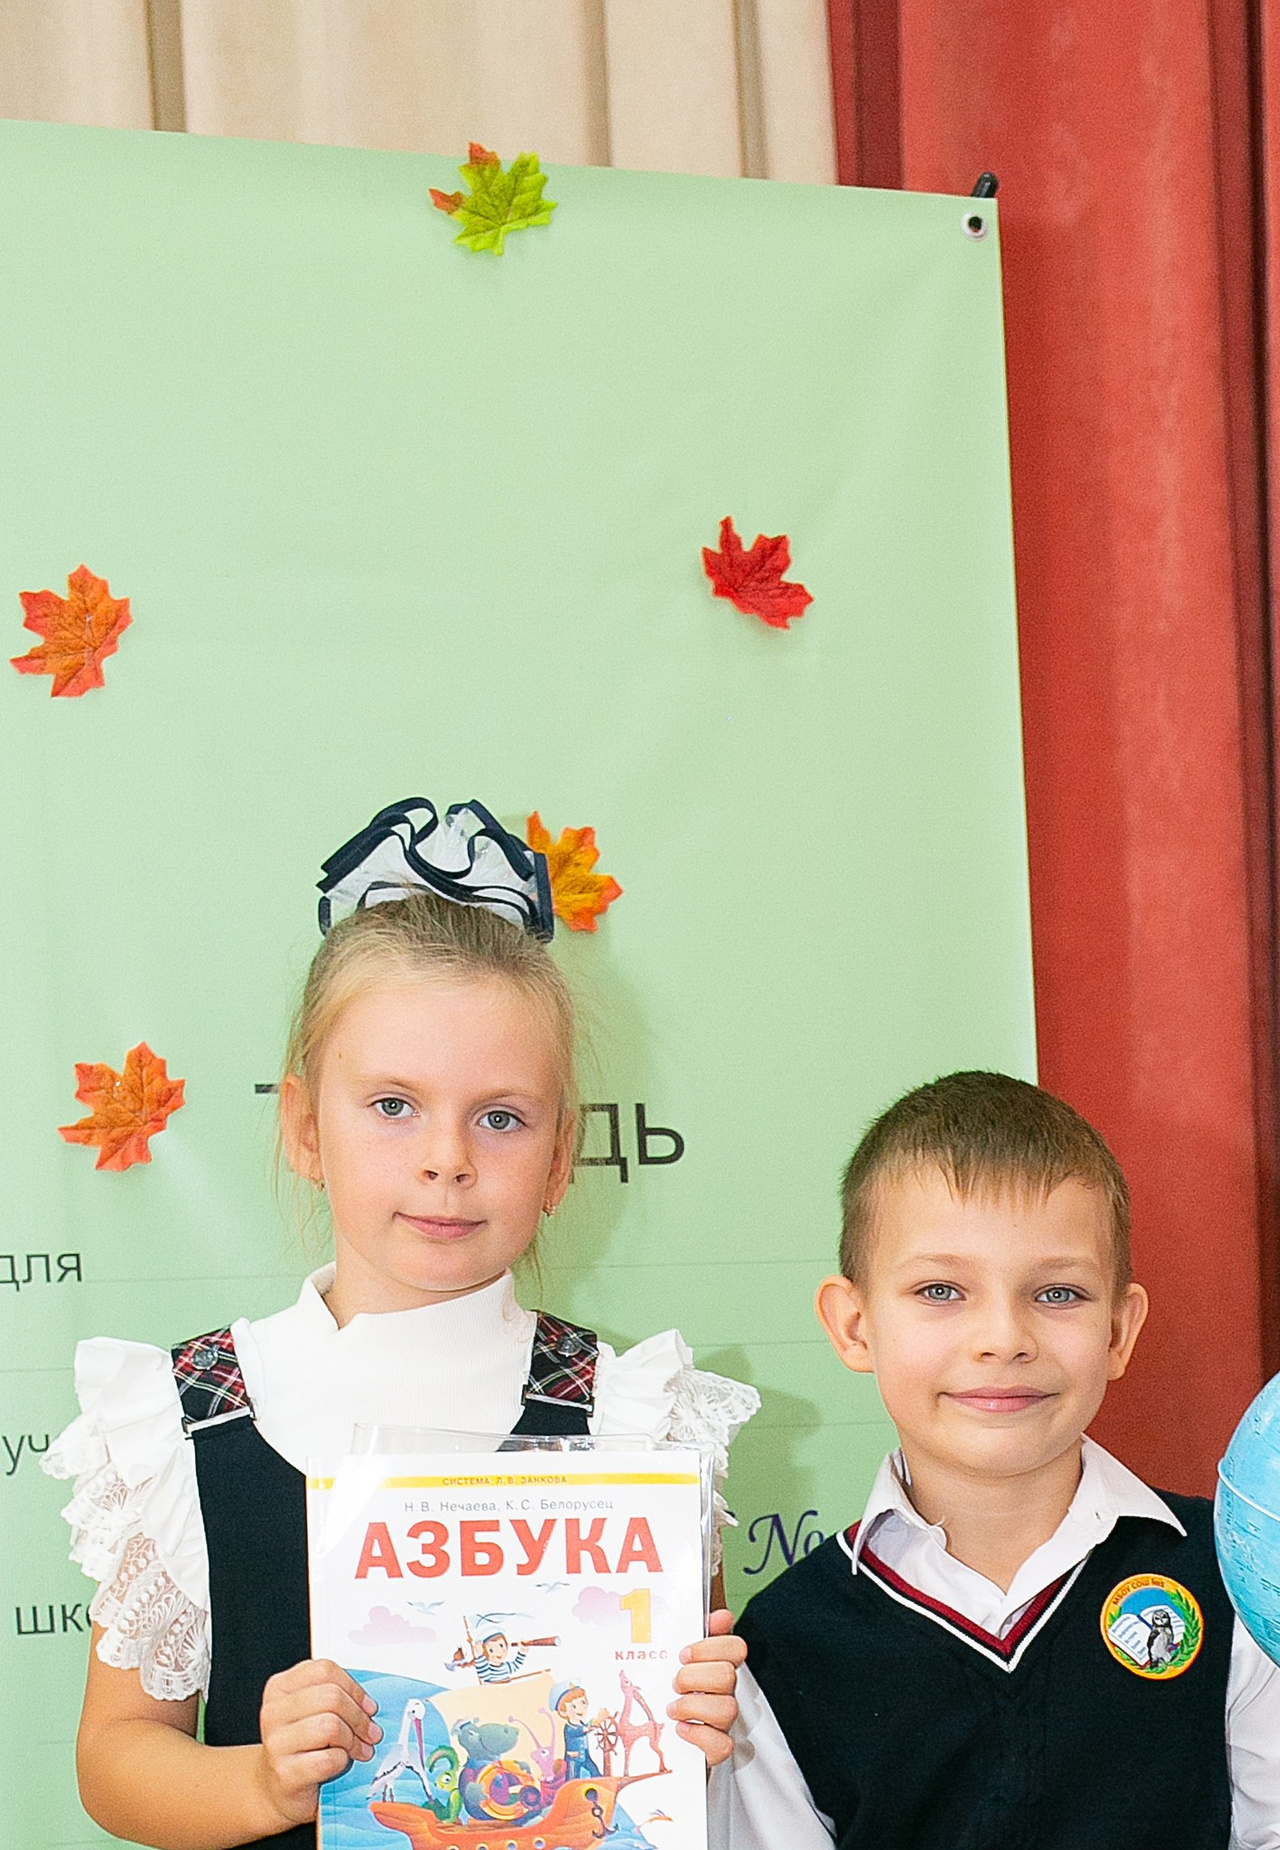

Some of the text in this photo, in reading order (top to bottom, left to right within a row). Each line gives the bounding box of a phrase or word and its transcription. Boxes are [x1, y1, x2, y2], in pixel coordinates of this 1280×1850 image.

[443, 1477, 491, 1486] СИСТЕМА
[521, 1475, 568, 1485] ЗАНКОВА
[440, 1501, 500, 1513] Нечаева,
[540, 1498, 614, 1511] Белорусец
[354, 1516, 664, 1580] АЗБУКА
[619, 1588, 652, 1644] 1
[615, 1649, 668, 1661] класс
